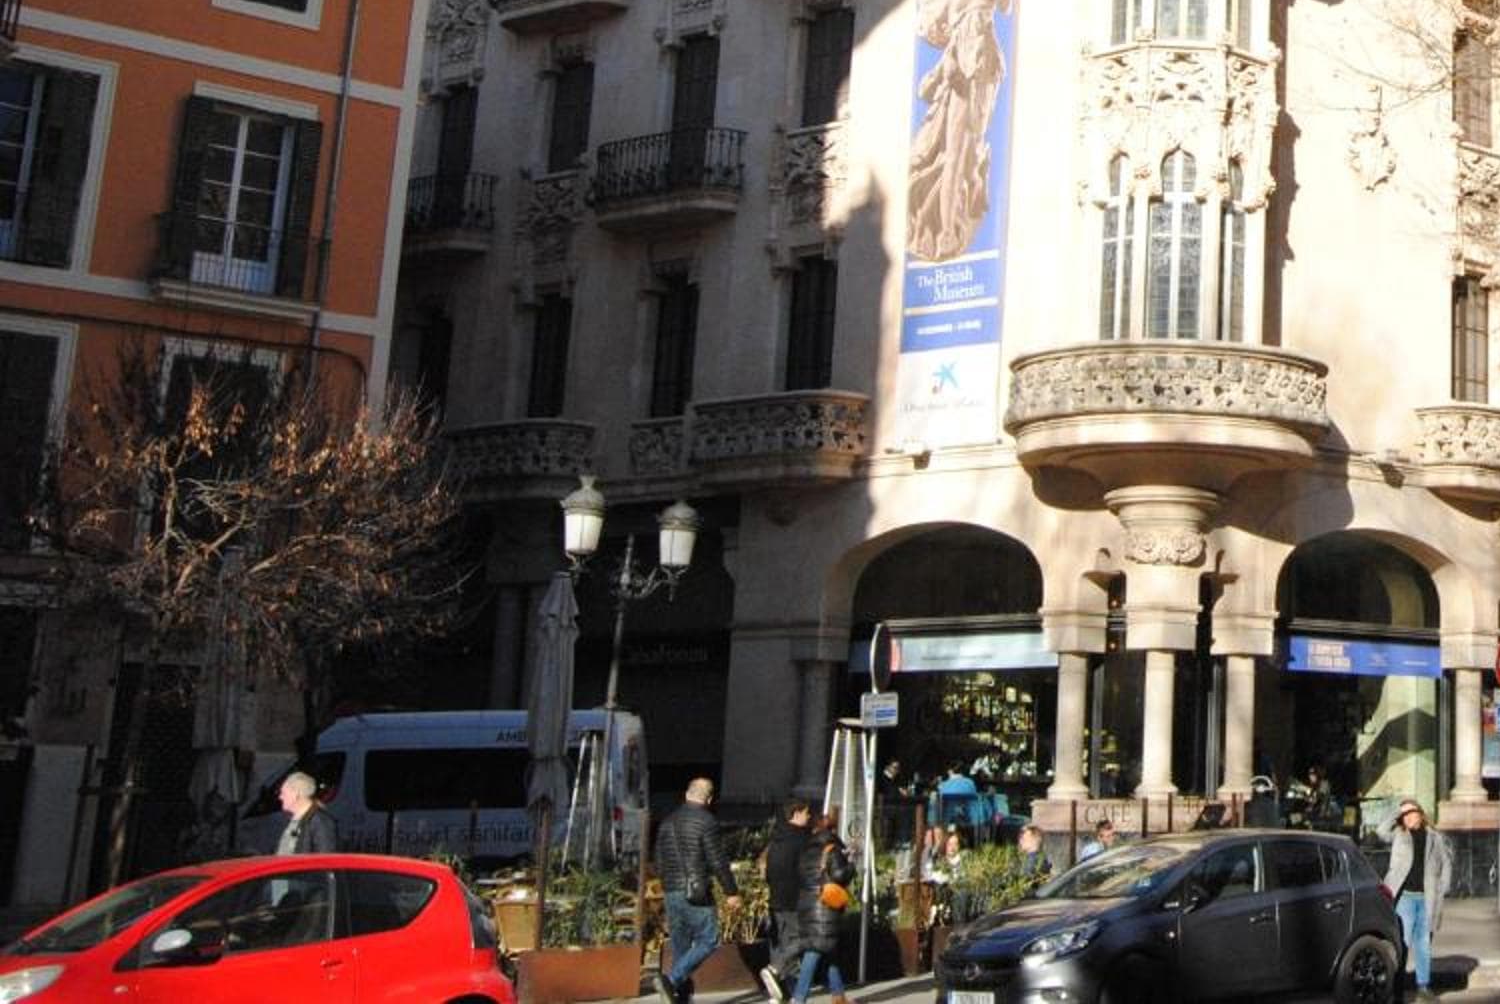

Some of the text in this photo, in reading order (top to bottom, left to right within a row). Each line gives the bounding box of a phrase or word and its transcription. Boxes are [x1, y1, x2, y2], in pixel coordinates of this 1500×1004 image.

[915, 266, 973, 288] The British
[933, 286, 985, 302] Museum
